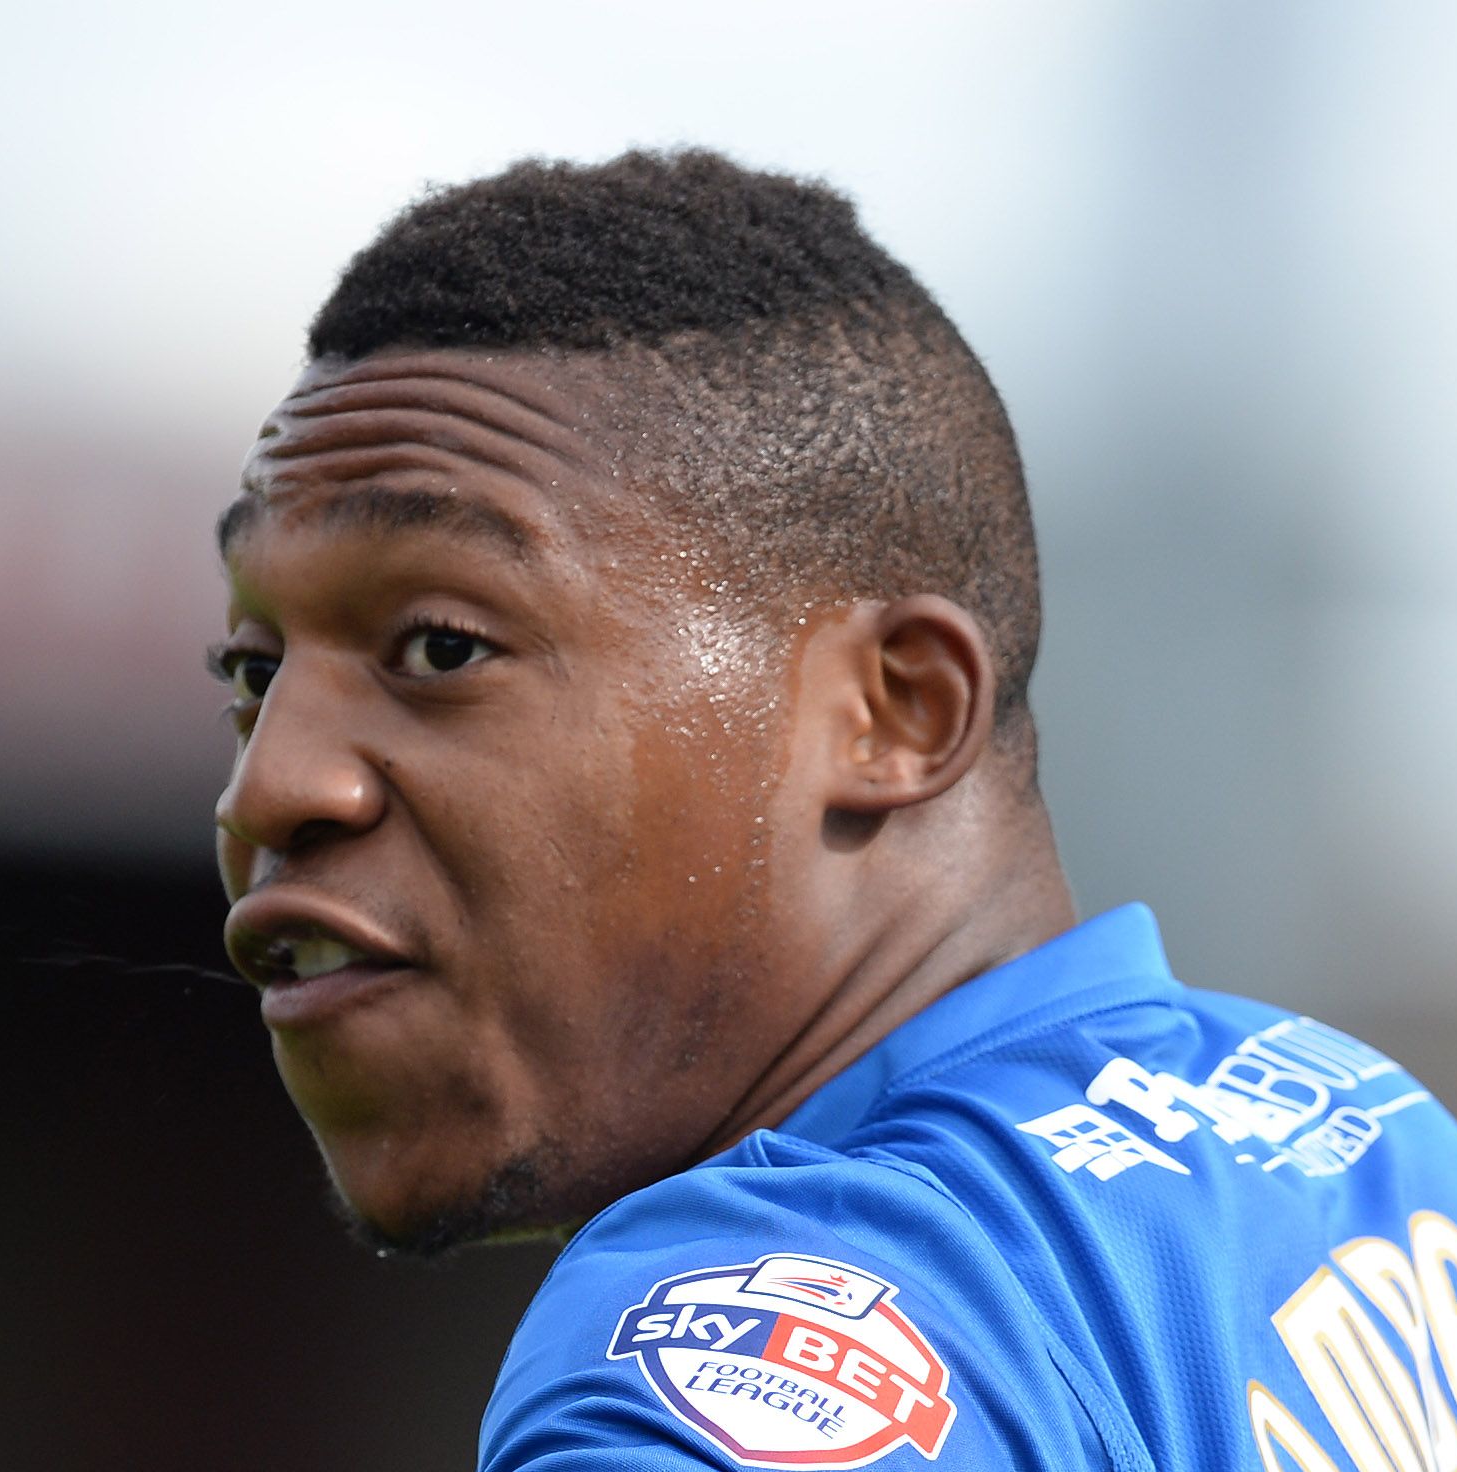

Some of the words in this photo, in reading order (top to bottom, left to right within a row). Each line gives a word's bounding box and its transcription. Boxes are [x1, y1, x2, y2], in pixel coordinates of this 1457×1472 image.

[631, 1304, 762, 1350] sky
[782, 1325, 935, 1423] BET
[697, 1361, 846, 1423] FOOTBALL
[685, 1375, 843, 1439] LEAGUE
